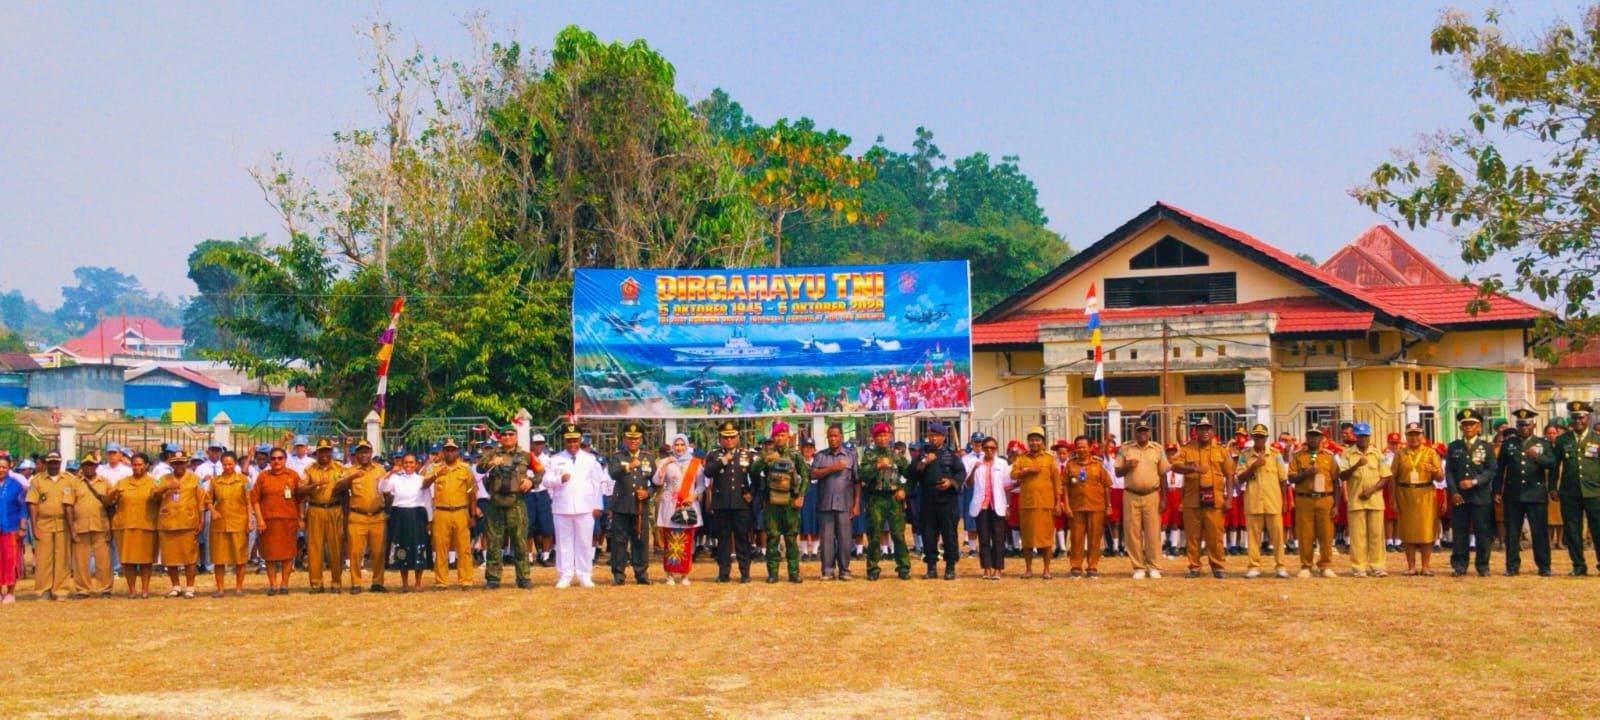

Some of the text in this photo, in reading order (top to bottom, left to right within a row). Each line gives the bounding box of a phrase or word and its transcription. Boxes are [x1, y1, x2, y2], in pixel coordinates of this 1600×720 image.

[656, 272, 884, 301] DIRGAHAYU TNI
[658, 303, 669, 315] 5
[673, 303, 728, 315] OKTOBER
[731, 302, 763, 315] 1945
[791, 301, 846, 313] OKTOBER
